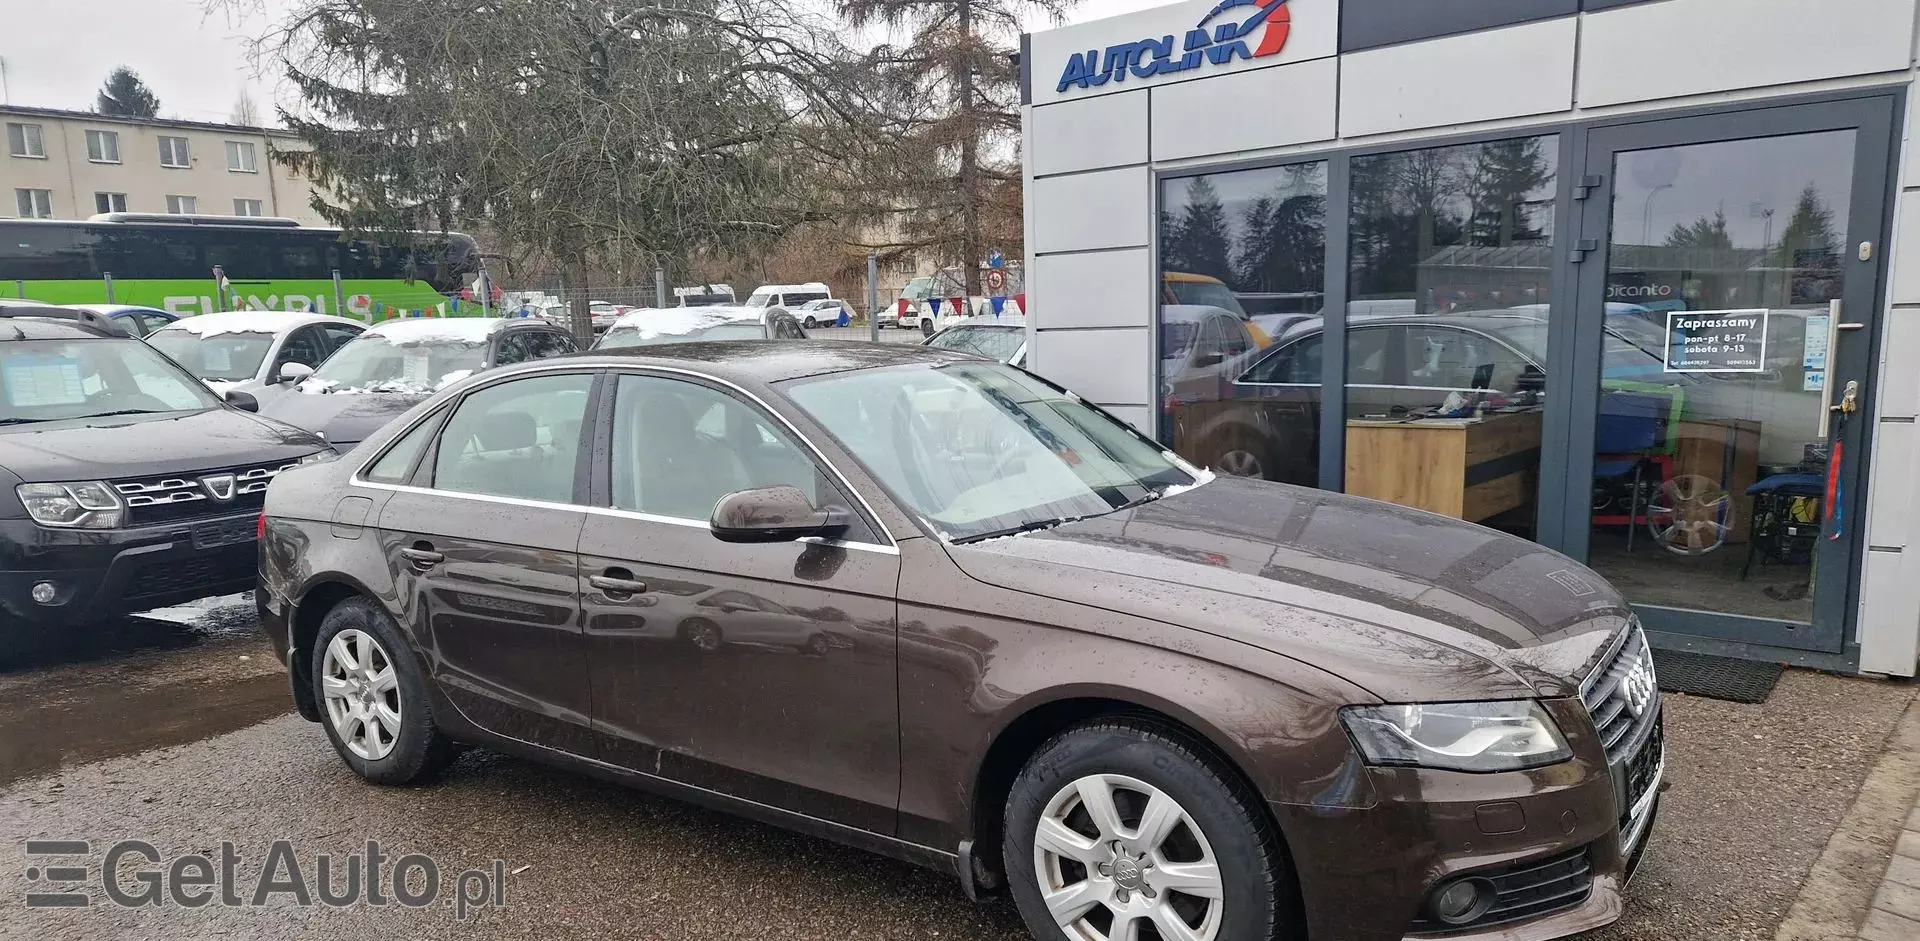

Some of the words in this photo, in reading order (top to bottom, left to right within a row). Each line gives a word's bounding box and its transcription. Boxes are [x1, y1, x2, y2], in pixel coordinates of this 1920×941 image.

[1056, 22, 1254, 92] AUTOLINK
[1676, 318, 1757, 331] Zapraszamy
[1684, 335, 1719, 345] pon-pt
[1724, 334, 1746, 342] 8-17
[1684, 346, 1718, 354] sobota
[1723, 345, 1745, 353] 9-13
